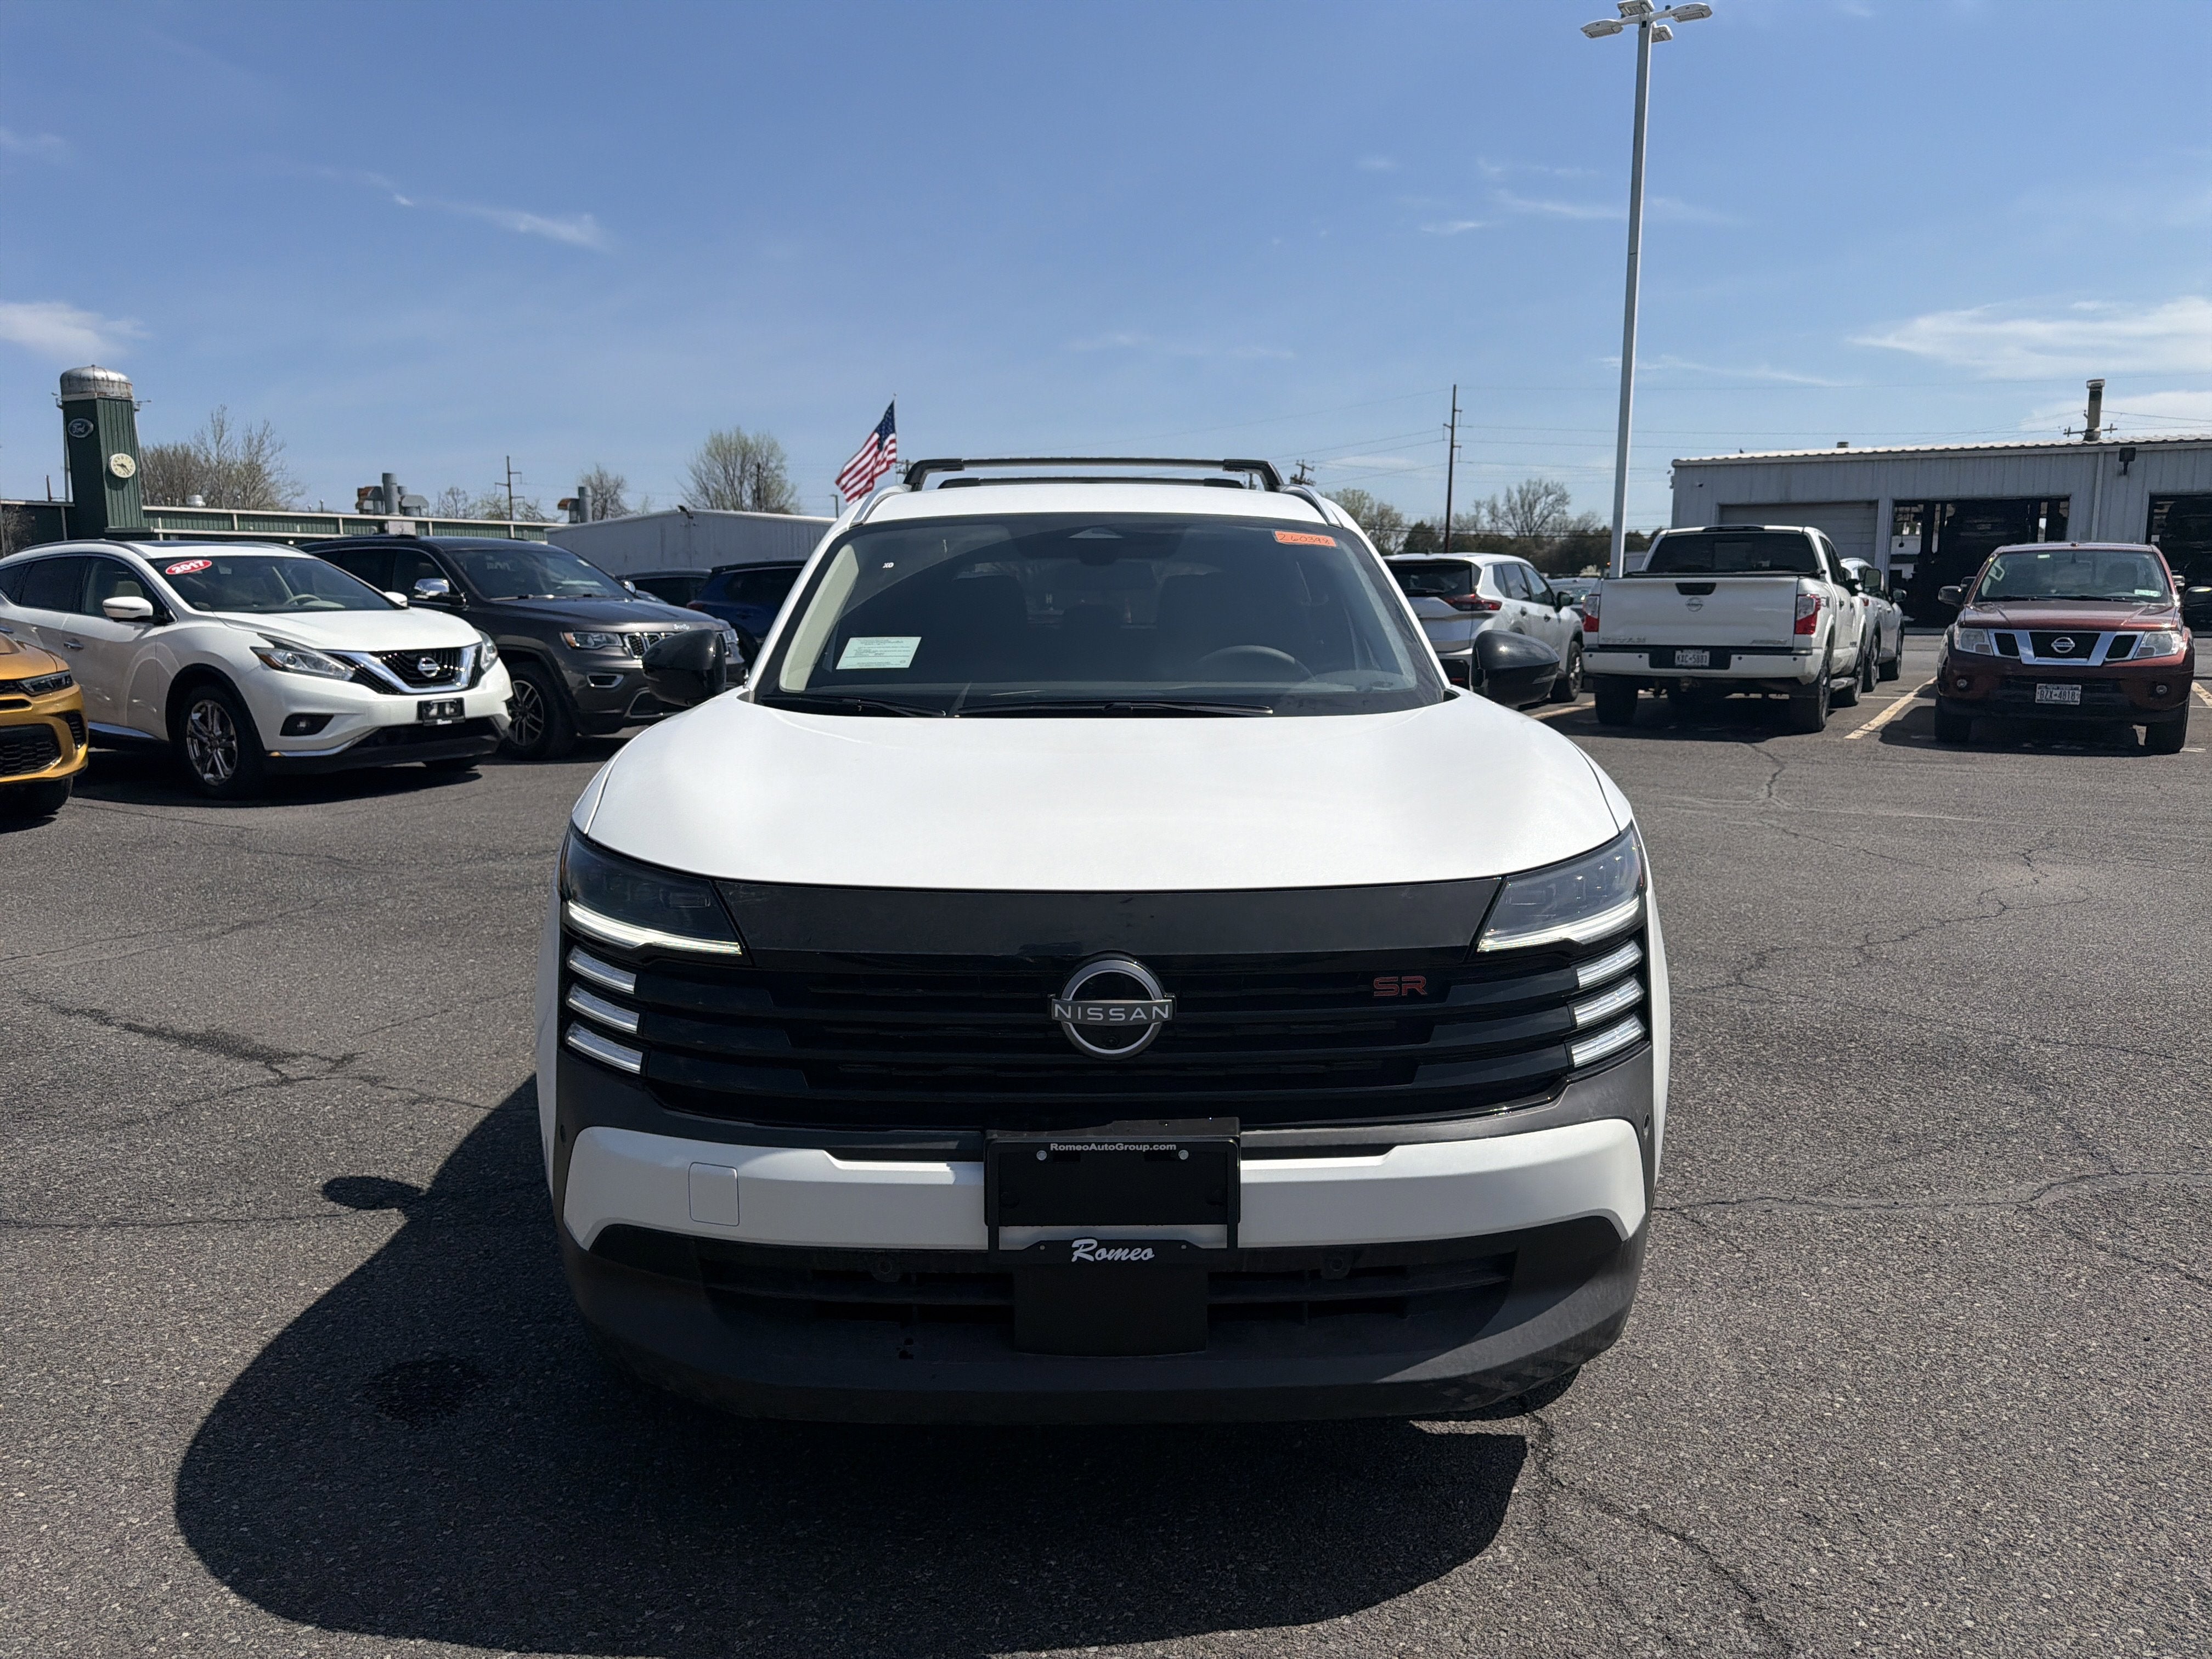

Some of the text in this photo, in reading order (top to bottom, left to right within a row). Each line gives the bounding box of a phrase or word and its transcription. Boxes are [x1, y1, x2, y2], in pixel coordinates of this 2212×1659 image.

[171, 560, 205, 574] 2017
[1373, 975, 1427, 996] SR
[1054, 1003, 1169, 1021] NISSAN
[1050, 1143, 1177, 1152] RomeoAutoGroup.com
[1071, 1238, 1155, 1262] Romeo
